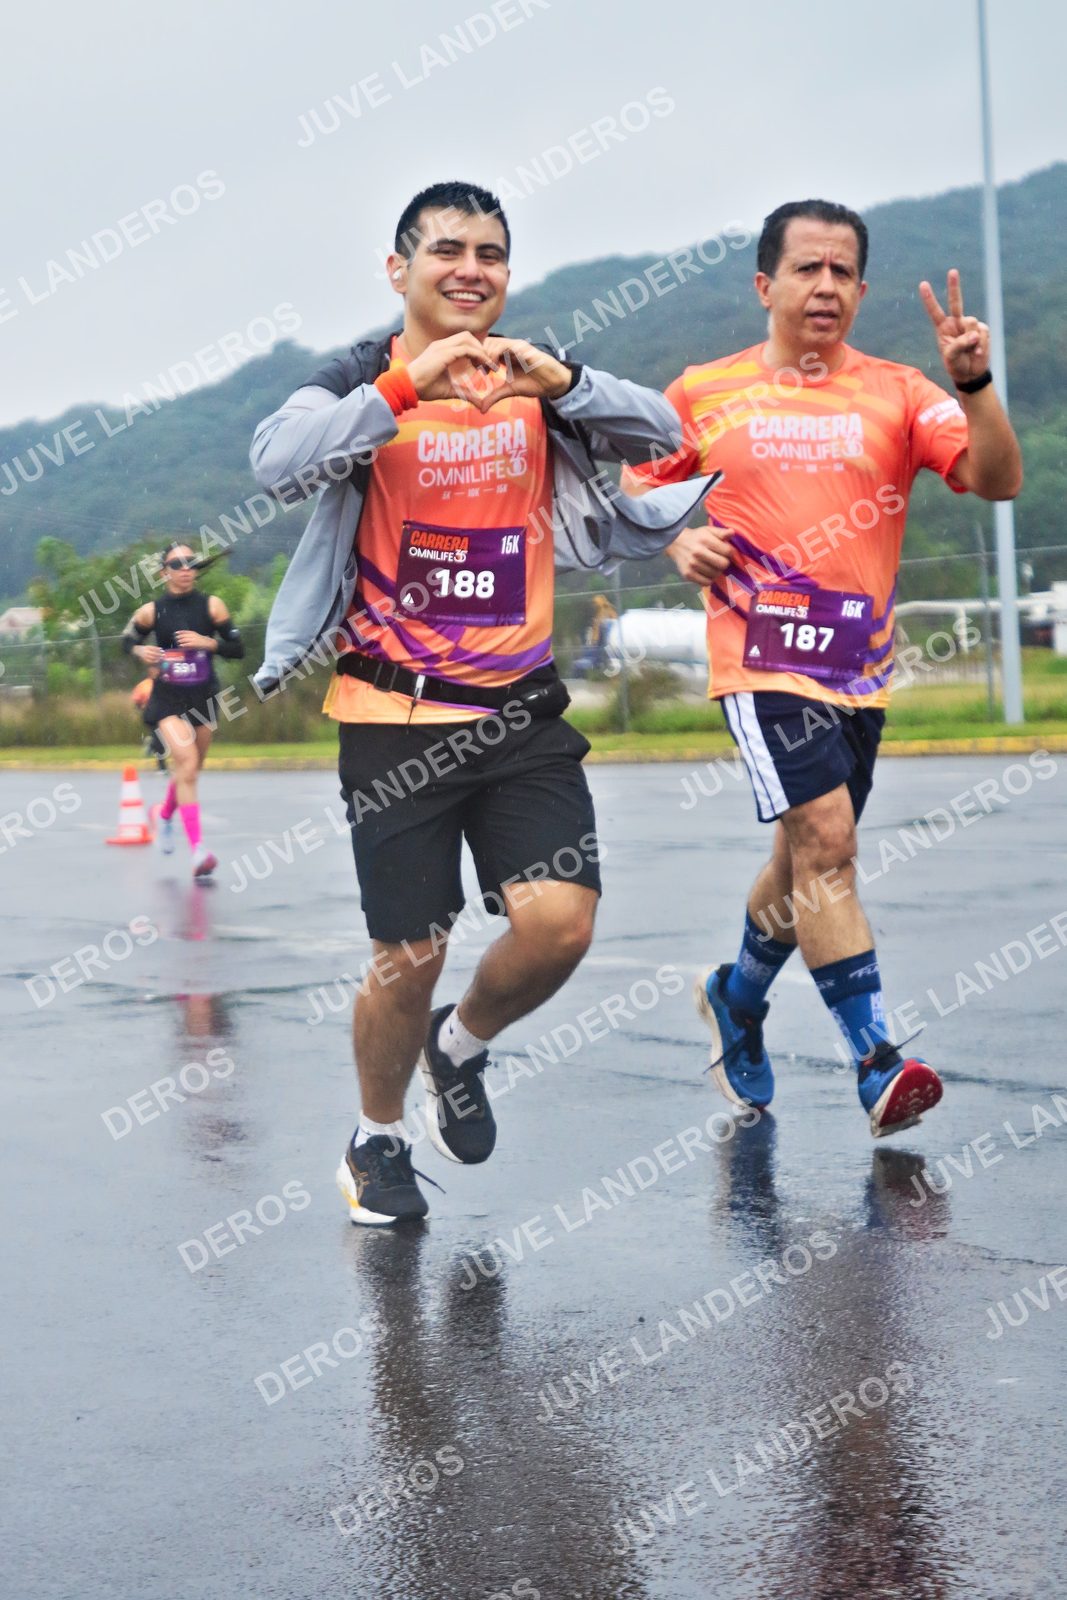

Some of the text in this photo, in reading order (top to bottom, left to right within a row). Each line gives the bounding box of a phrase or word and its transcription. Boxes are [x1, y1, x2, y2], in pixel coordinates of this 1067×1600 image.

[748, 413, 863, 440] CARRERA
[418, 418, 527, 463] CARRERA
[410, 531, 469, 551] CARRERA
[501, 535, 520, 554] 15K
[435, 569, 495, 598] 188
[757, 590, 811, 607] CARRERA
[841, 600, 865, 618] 15K
[780, 622, 835, 652] 187
